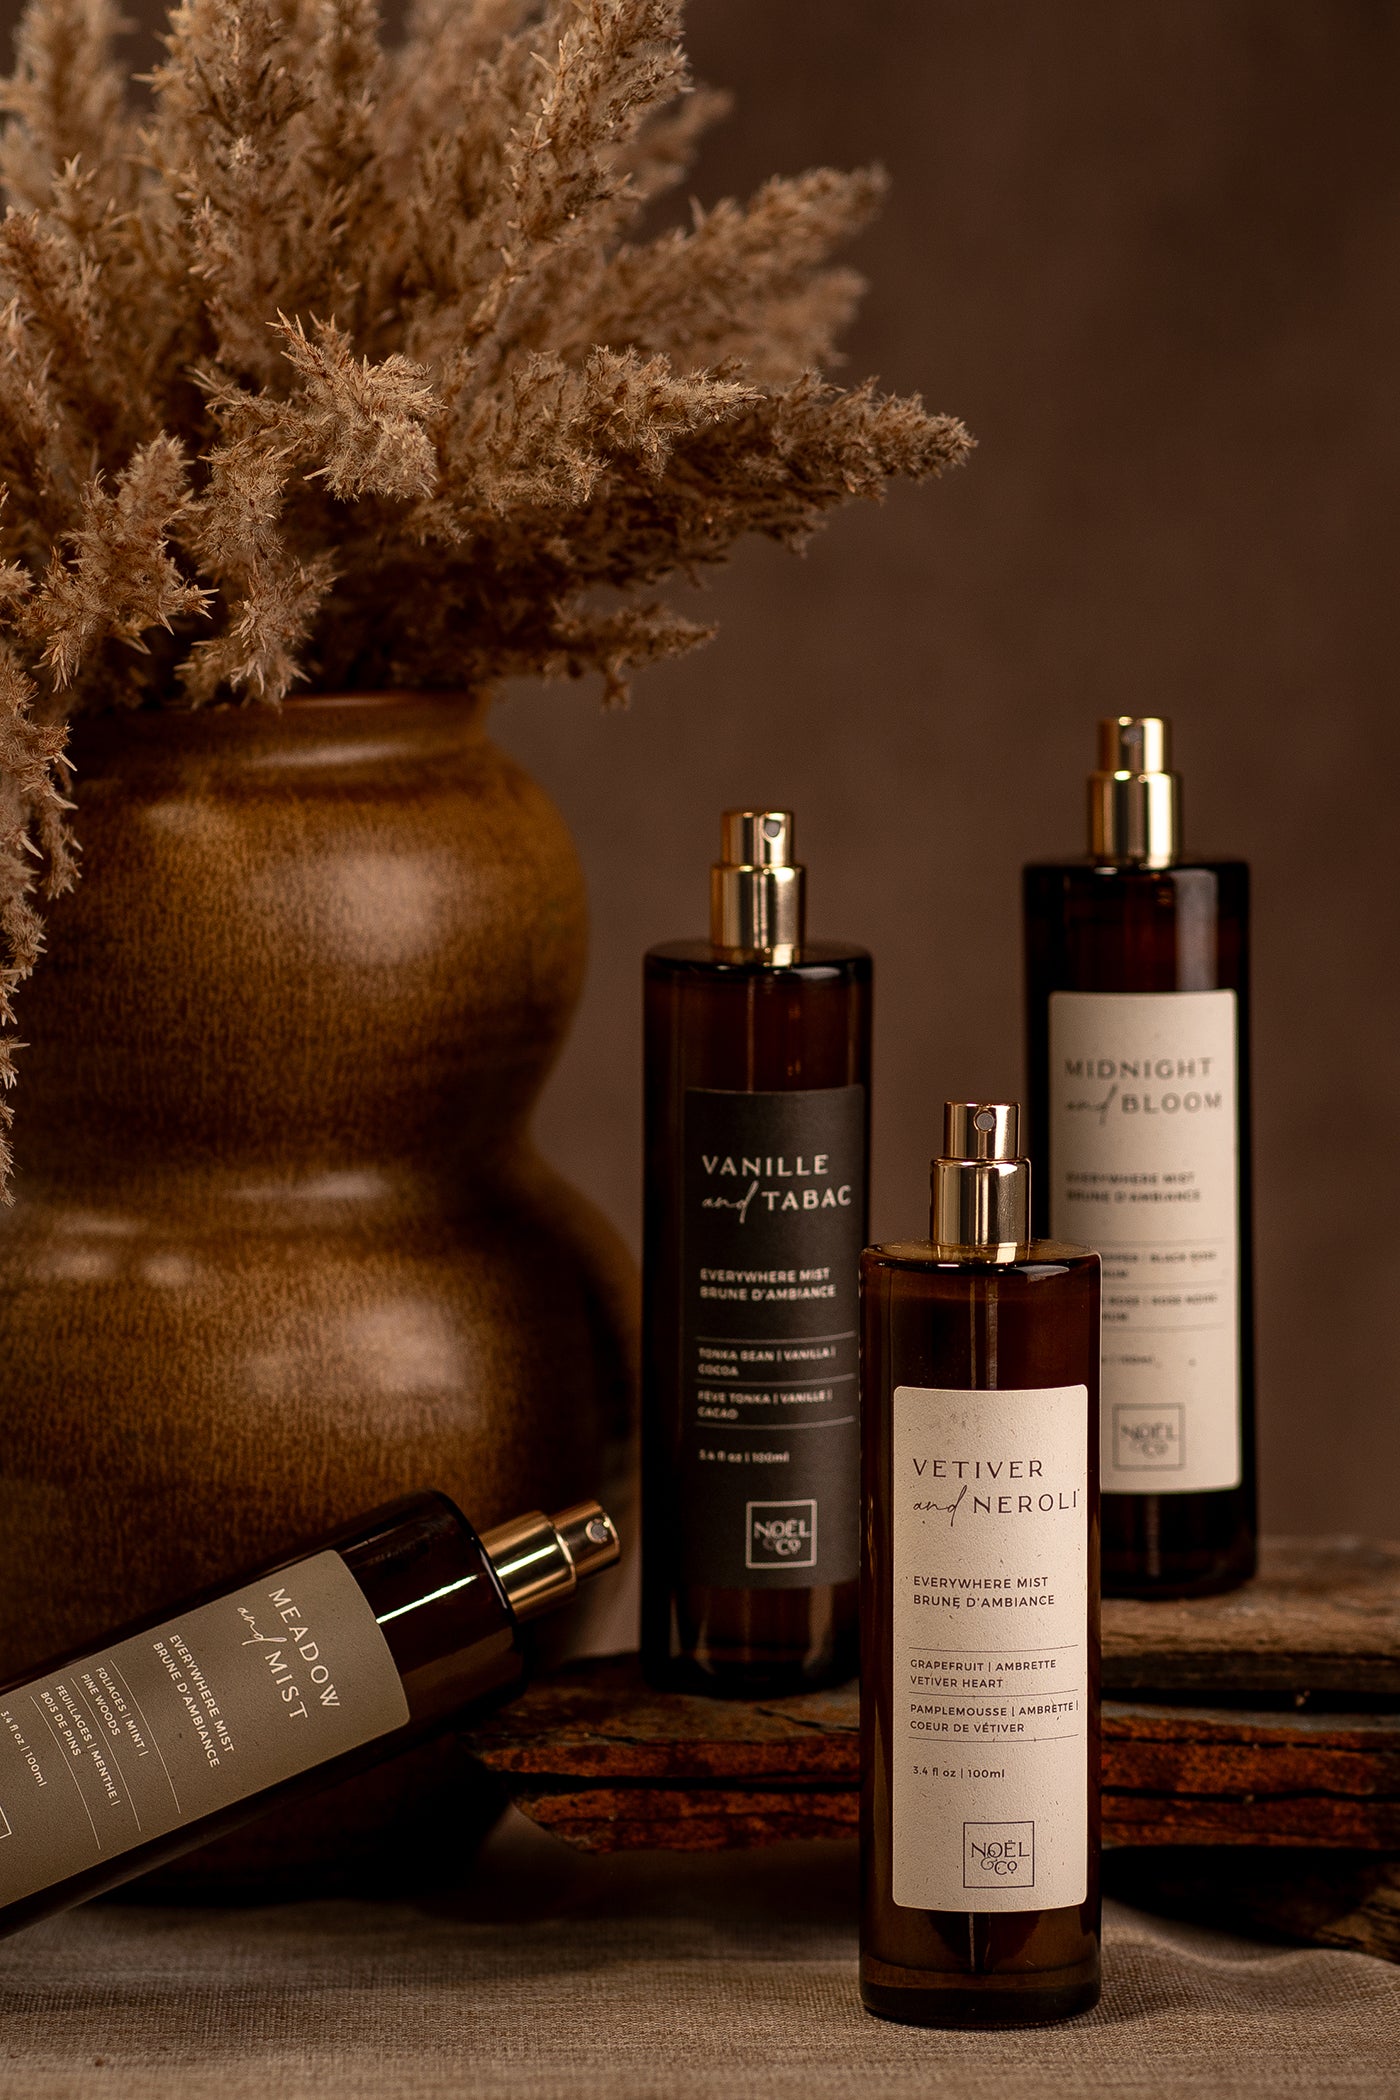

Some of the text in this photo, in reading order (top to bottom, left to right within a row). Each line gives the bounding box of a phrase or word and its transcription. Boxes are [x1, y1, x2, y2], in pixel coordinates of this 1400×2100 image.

[1065, 1057, 1212, 1080] MIDNIGHT
[1121, 1091, 1222, 1115] BLOOM
[702, 1154, 829, 1177] VANILLE
[702, 1180, 852, 1224] and TABAC
[700, 1266, 830, 1283] EVERYWHERE MIST
[700, 1284, 837, 1301] BRUNE D'AMBIANCE
[740, 1349, 774, 1362] BEAN
[698, 1364, 739, 1377] COCOA
[698, 1406, 739, 1420] CACAO
[913, 1458, 1043, 1479] VETIVER
[912, 1484, 1077, 1527] and NEROLI
[913, 1575, 1048, 1589] EVERYWHERE MIST
[913, 1594, 1055, 1608] BRUNE D'AMBIANCE
[268, 1587, 341, 1707] MEADOW
[237, 1607, 308, 1719] and MIST
[910, 1659, 1057, 1672] GRAPEFRUIT AMBRETTE
[910, 1675, 1004, 1688] VETIVER HEART
[169, 1634, 235, 1752] EVERYWHERE MIST
[81, 1673, 121, 1736] PINE WOODS
[95, 1667, 146, 1749] FOLIAGES MINT
[152, 1641, 220, 1768] BRUNE D'AMBIANCE
[910, 1702, 1074, 1717] PAMPLEMOUSSE AMBRETTE
[40, 1691, 82, 1756] BOIS DE PINS
[910, 1720, 1025, 1733] COEUR DE VÉTIVER
[0, 1710, 12, 1724] 3.4
[14, 1733, 25, 1746] oz
[25, 1752, 48, 1787] 100ml
[55, 1685, 118, 1799] FEUILLAGES MENTHE
[912, 1766, 1005, 1778] 3.4 fl oz 100ml
[971, 1839, 1031, 1858] NOËL
